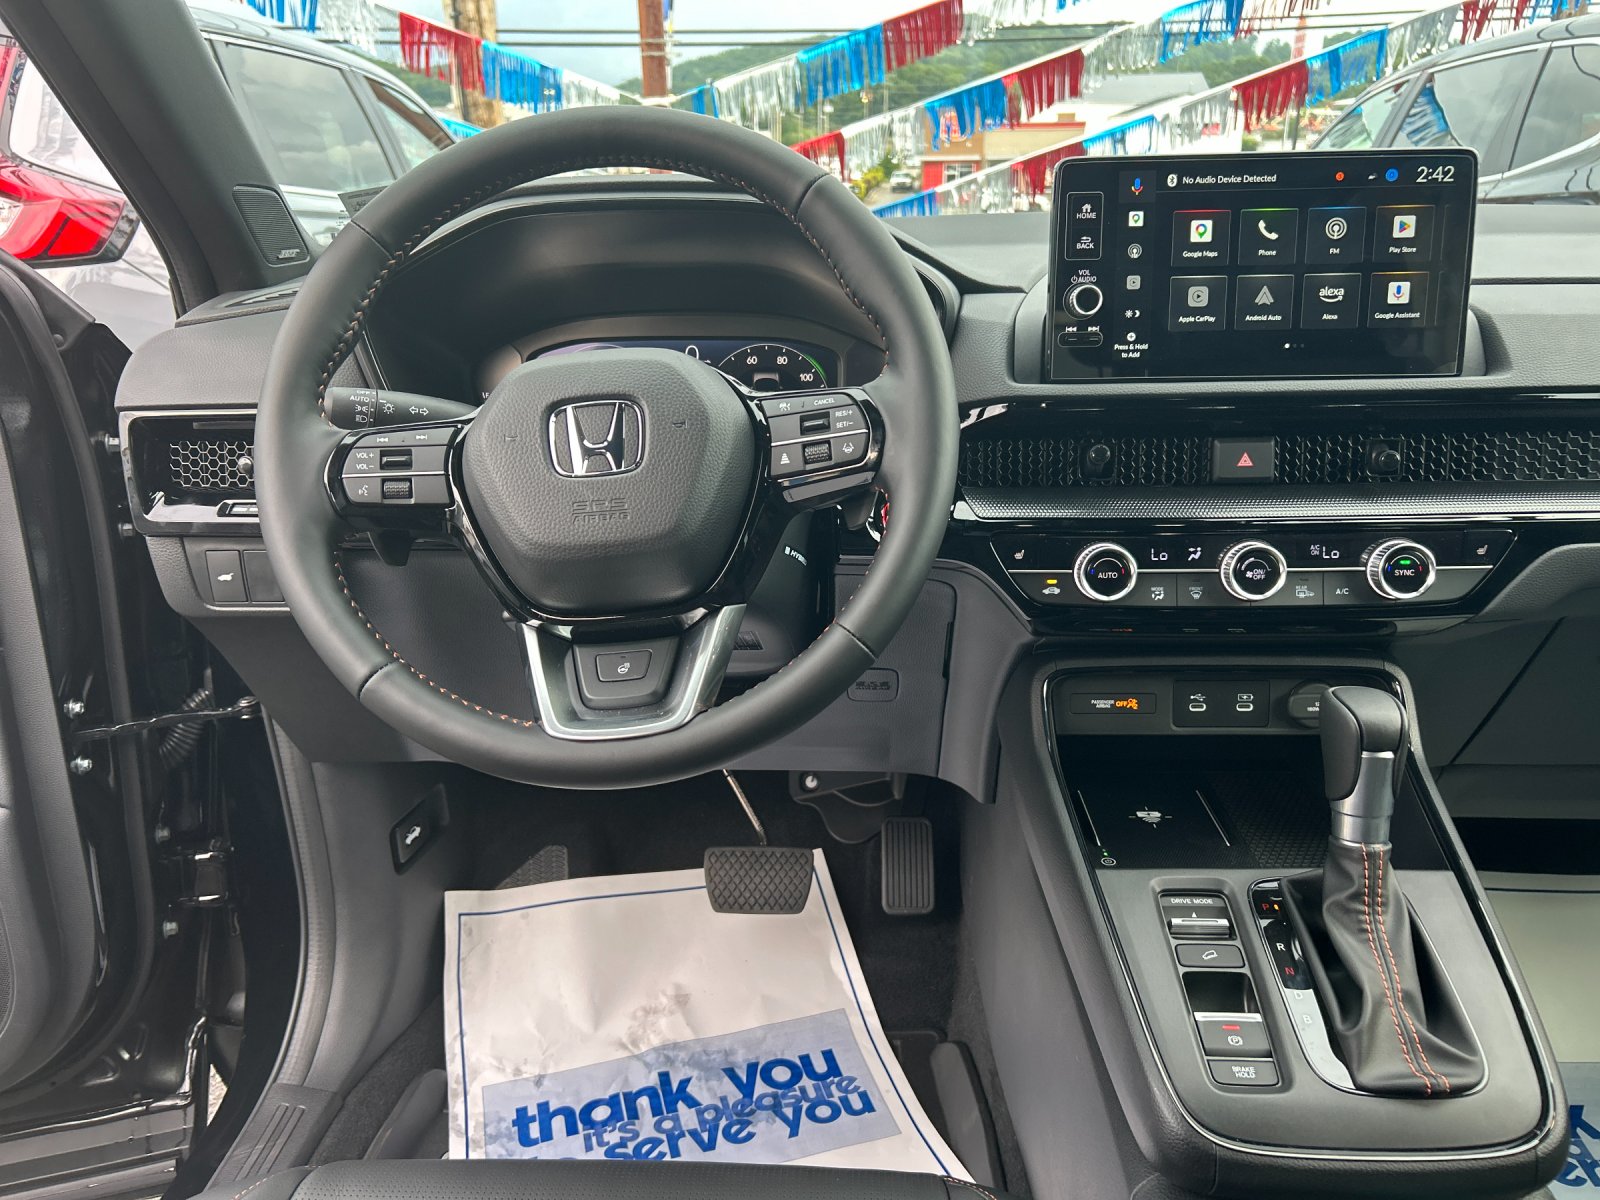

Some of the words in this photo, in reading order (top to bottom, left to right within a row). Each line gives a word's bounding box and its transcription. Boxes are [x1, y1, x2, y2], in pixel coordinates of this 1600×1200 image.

[1416, 165, 1455, 183] 2:42
[1183, 176, 1193, 184] No
[1195, 175, 1216, 184] Audio
[1217, 175, 1241, 184] Device
[1243, 174, 1277, 183] Detected
[1182, 250, 1202, 258] Google
[1203, 250, 1218, 258] Maps
[1388, 246, 1402, 254] Play
[1319, 286, 1345, 297] alexa
[1195, 315, 1216, 323] CarPlay
[1374, 312, 1395, 320] Google
[746, 356, 758, 365] 60
[776, 356, 788, 364] 80
[800, 374, 814, 382] 100
[813, 397, 835, 406] CANCEL
[1151, 549, 1168, 561] Lo
[1322, 546, 1340, 559] Lo
[1394, 569, 1415, 577] SYNC
[1276, 942, 1286, 951] R
[1285, 967, 1295, 975] N
[1303, 1015, 1312, 1024] B
[512, 1071, 704, 1147] thank
[721, 1048, 844, 1103] you
[582, 1119, 641, 1153] it's
[653, 1112, 687, 1134] a
[695, 1075, 861, 1133] pleasure
[603, 1117, 757, 1160] serve
[771, 1089, 877, 1139] you
